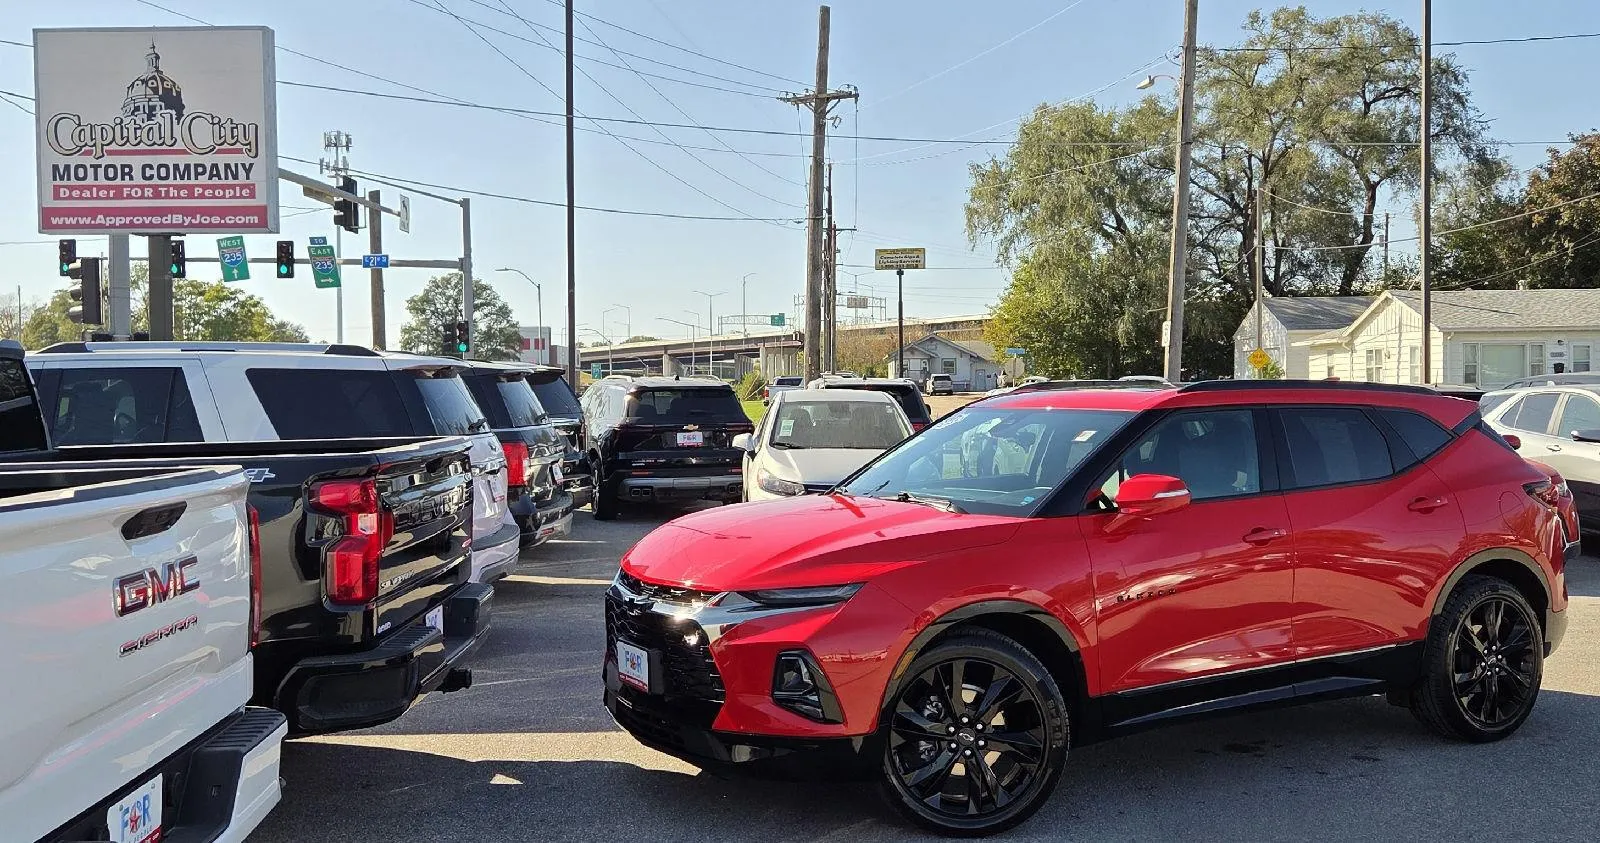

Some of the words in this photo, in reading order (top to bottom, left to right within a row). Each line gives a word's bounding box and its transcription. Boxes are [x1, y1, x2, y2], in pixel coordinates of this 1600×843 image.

[46, 112, 177, 160] Capital
[181, 111, 259, 159] City
[51, 163, 134, 182] MOTOR
[141, 162, 254, 181] COMPANY
[59, 187, 116, 198] Dealer
[122, 187, 153, 198] FOR
[158, 187, 189, 197] The
[194, 186, 251, 199] People
[50, 213, 259, 227] www.ApprovedByJoe.com
[220, 239, 241, 247] WEST
[224, 252, 243, 263] 235
[310, 247, 331, 255] EAST
[315, 261, 333, 270] 235
[112, 554, 201, 618] GMC
